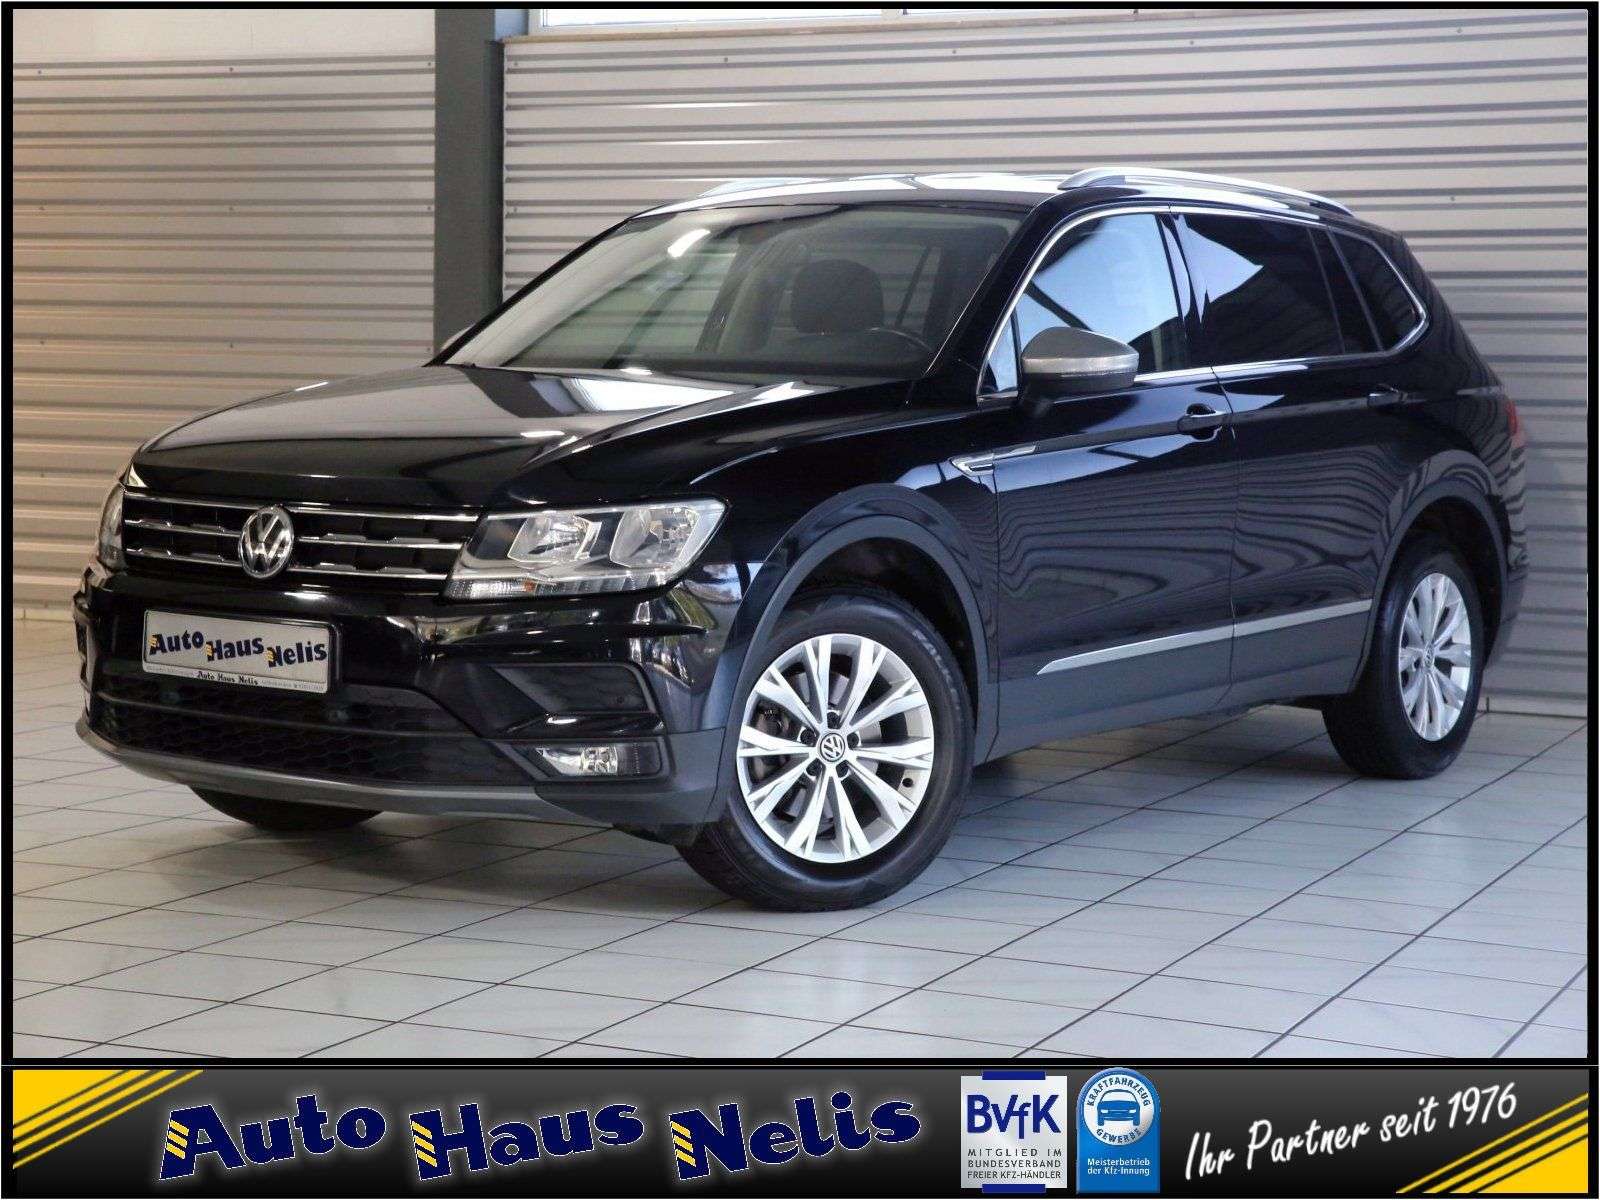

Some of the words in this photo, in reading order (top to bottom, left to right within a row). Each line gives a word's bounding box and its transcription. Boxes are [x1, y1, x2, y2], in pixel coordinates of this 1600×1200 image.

[148, 630, 204, 655] Auto
[206, 637, 264, 662] Haus
[265, 641, 327, 668] Nelis
[197, 670, 215, 681] Auto
[217, 673, 235, 683] Haus
[238, 675, 258, 686] Nelis
